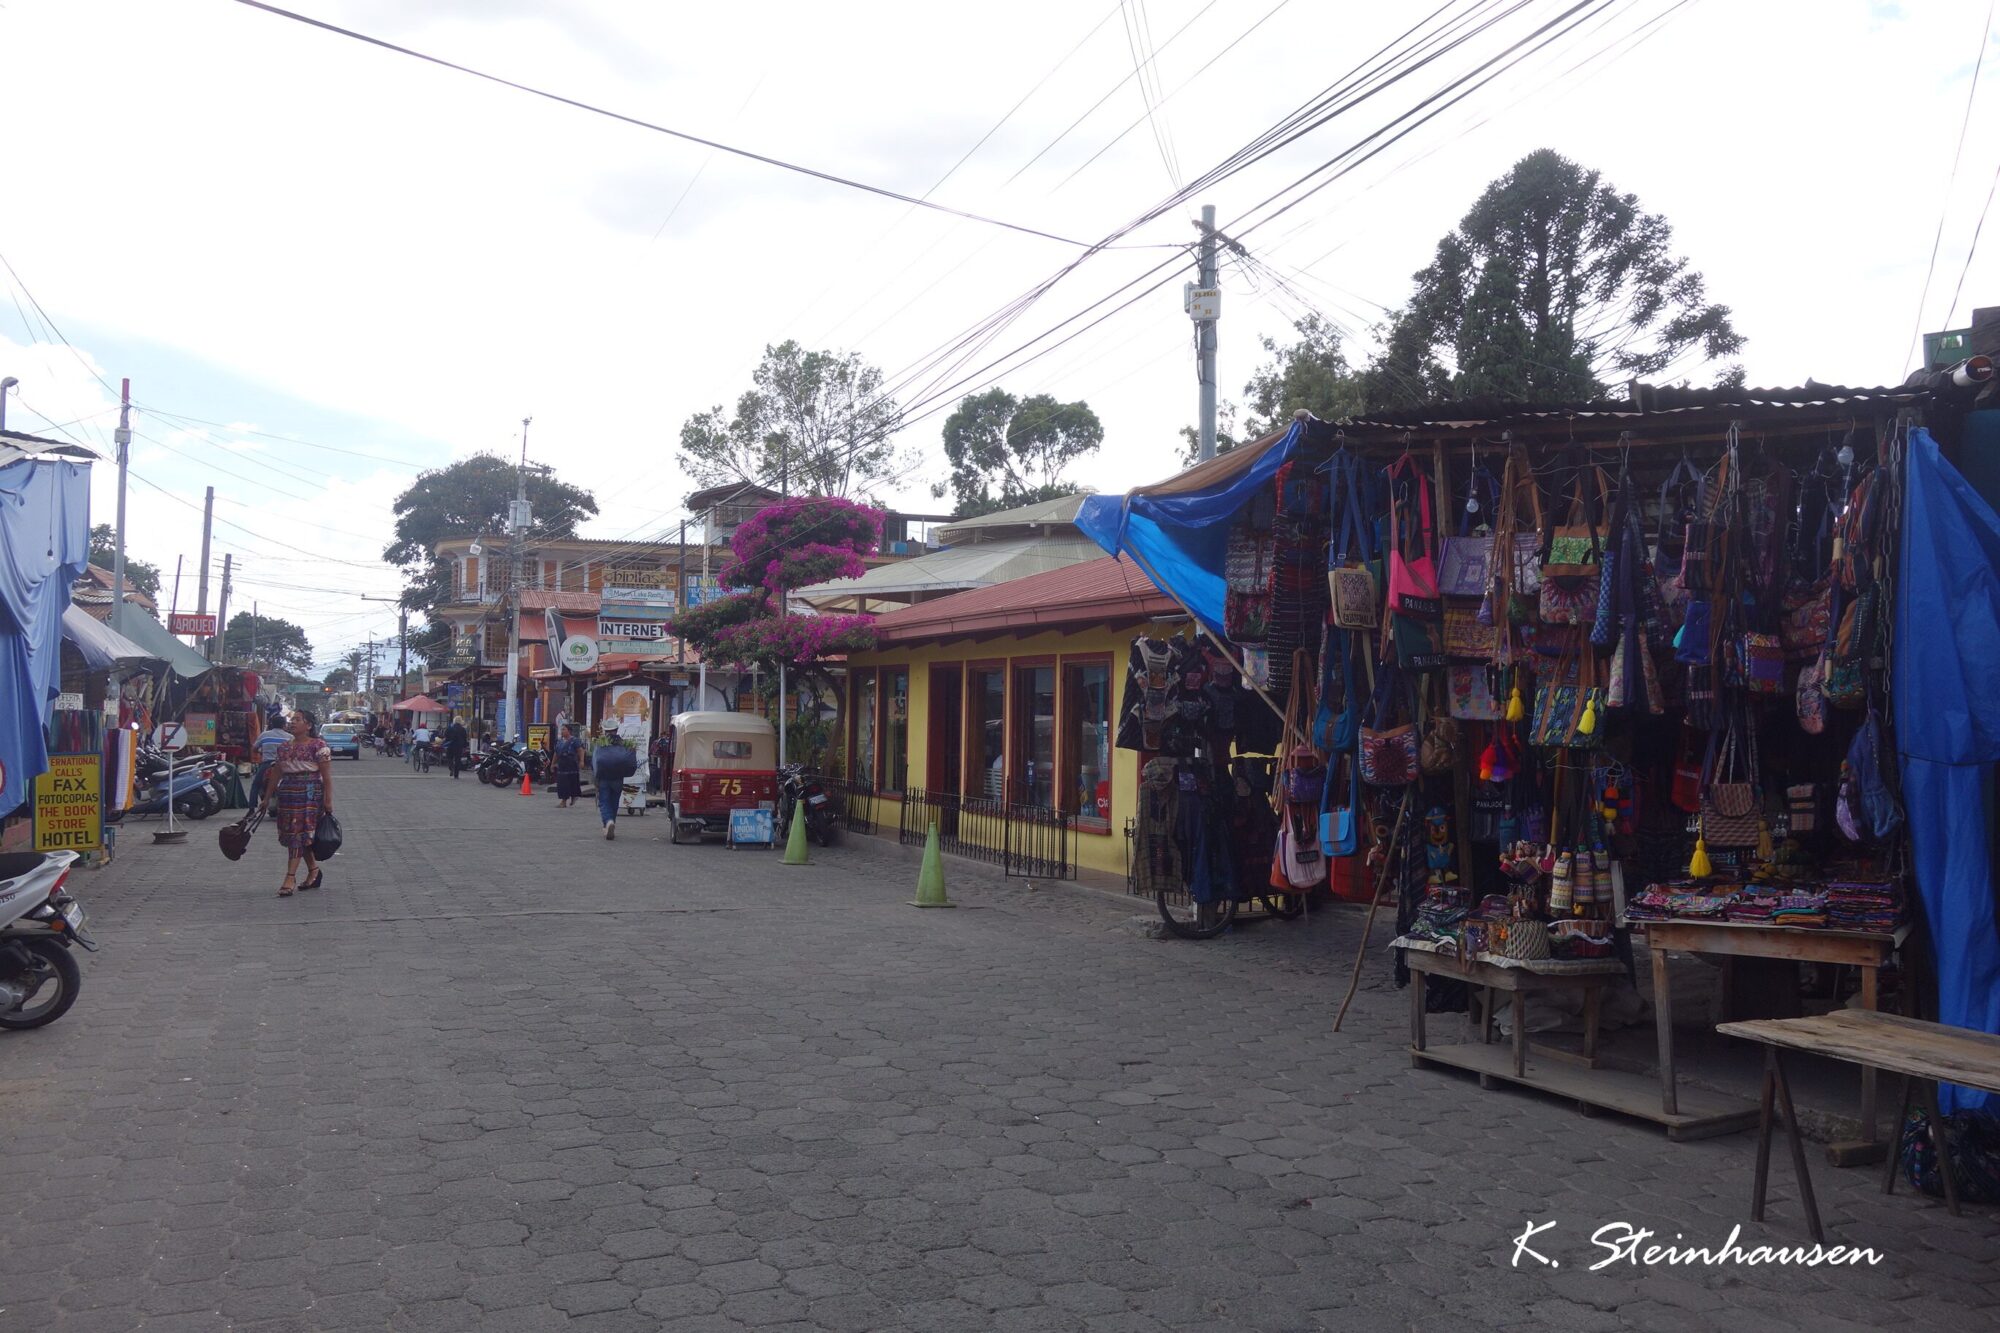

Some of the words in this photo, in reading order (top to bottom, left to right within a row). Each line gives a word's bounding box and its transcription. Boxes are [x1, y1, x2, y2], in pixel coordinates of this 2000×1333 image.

[601, 623, 664, 636] INTERNET
[51, 756, 97, 767] ERNATIONAL
[55, 768, 82, 777] CALLS
[53, 778, 87, 791] FAX
[719, 779, 742, 796] 75
[38, 793, 99, 805] FOTOCOPIAS
[39, 806, 59, 817] THE
[64, 804, 96, 816] BOOK
[48, 818, 87, 830] STORE
[42, 831, 93, 847] HOTEL
